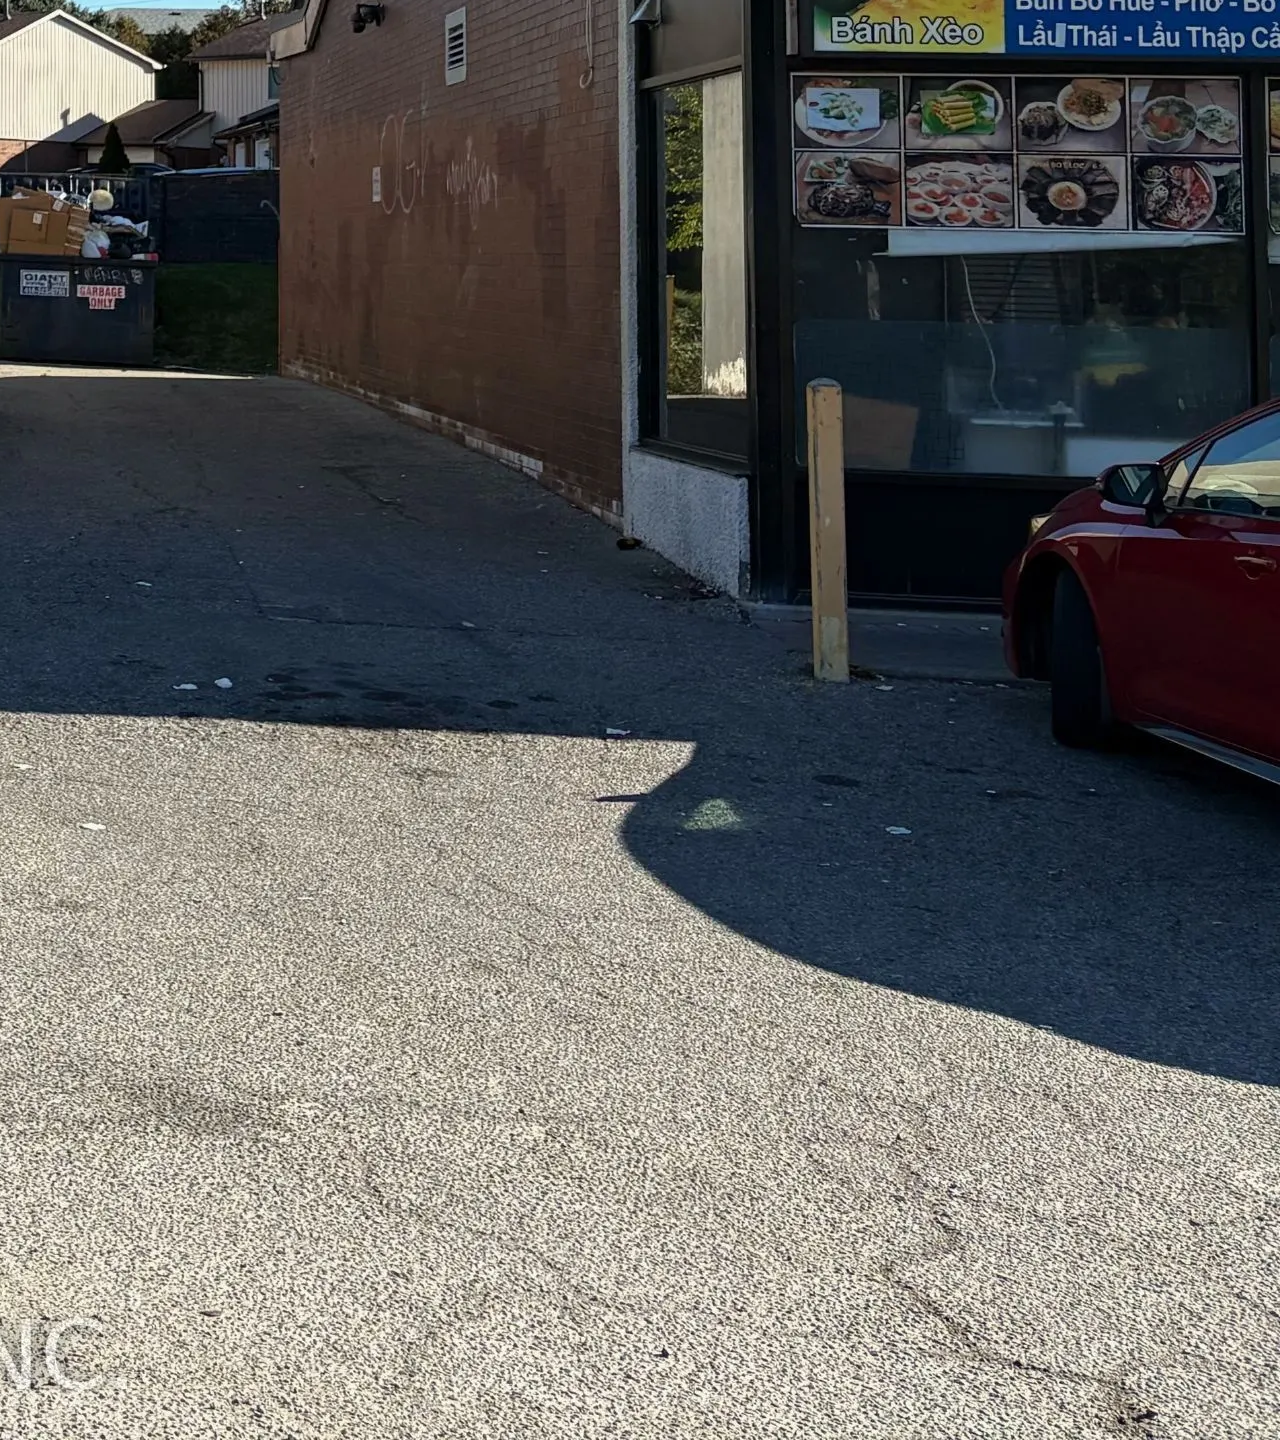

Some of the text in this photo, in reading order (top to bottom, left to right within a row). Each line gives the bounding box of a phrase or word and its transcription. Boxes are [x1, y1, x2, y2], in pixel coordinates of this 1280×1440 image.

[831, 15, 984, 45] Bánh Xèo
[1018, 20, 1057, 46] Lẩu
[1067, 24, 1117, 47] Thái
[1138, 21, 1180, 47] Lẩu
[1186, 25, 1245, 53] Thập
[24, 273, 65, 282] GIANT
[79, 286, 122, 297] GARBAGE
[91, 298, 114, 308] ONLY
